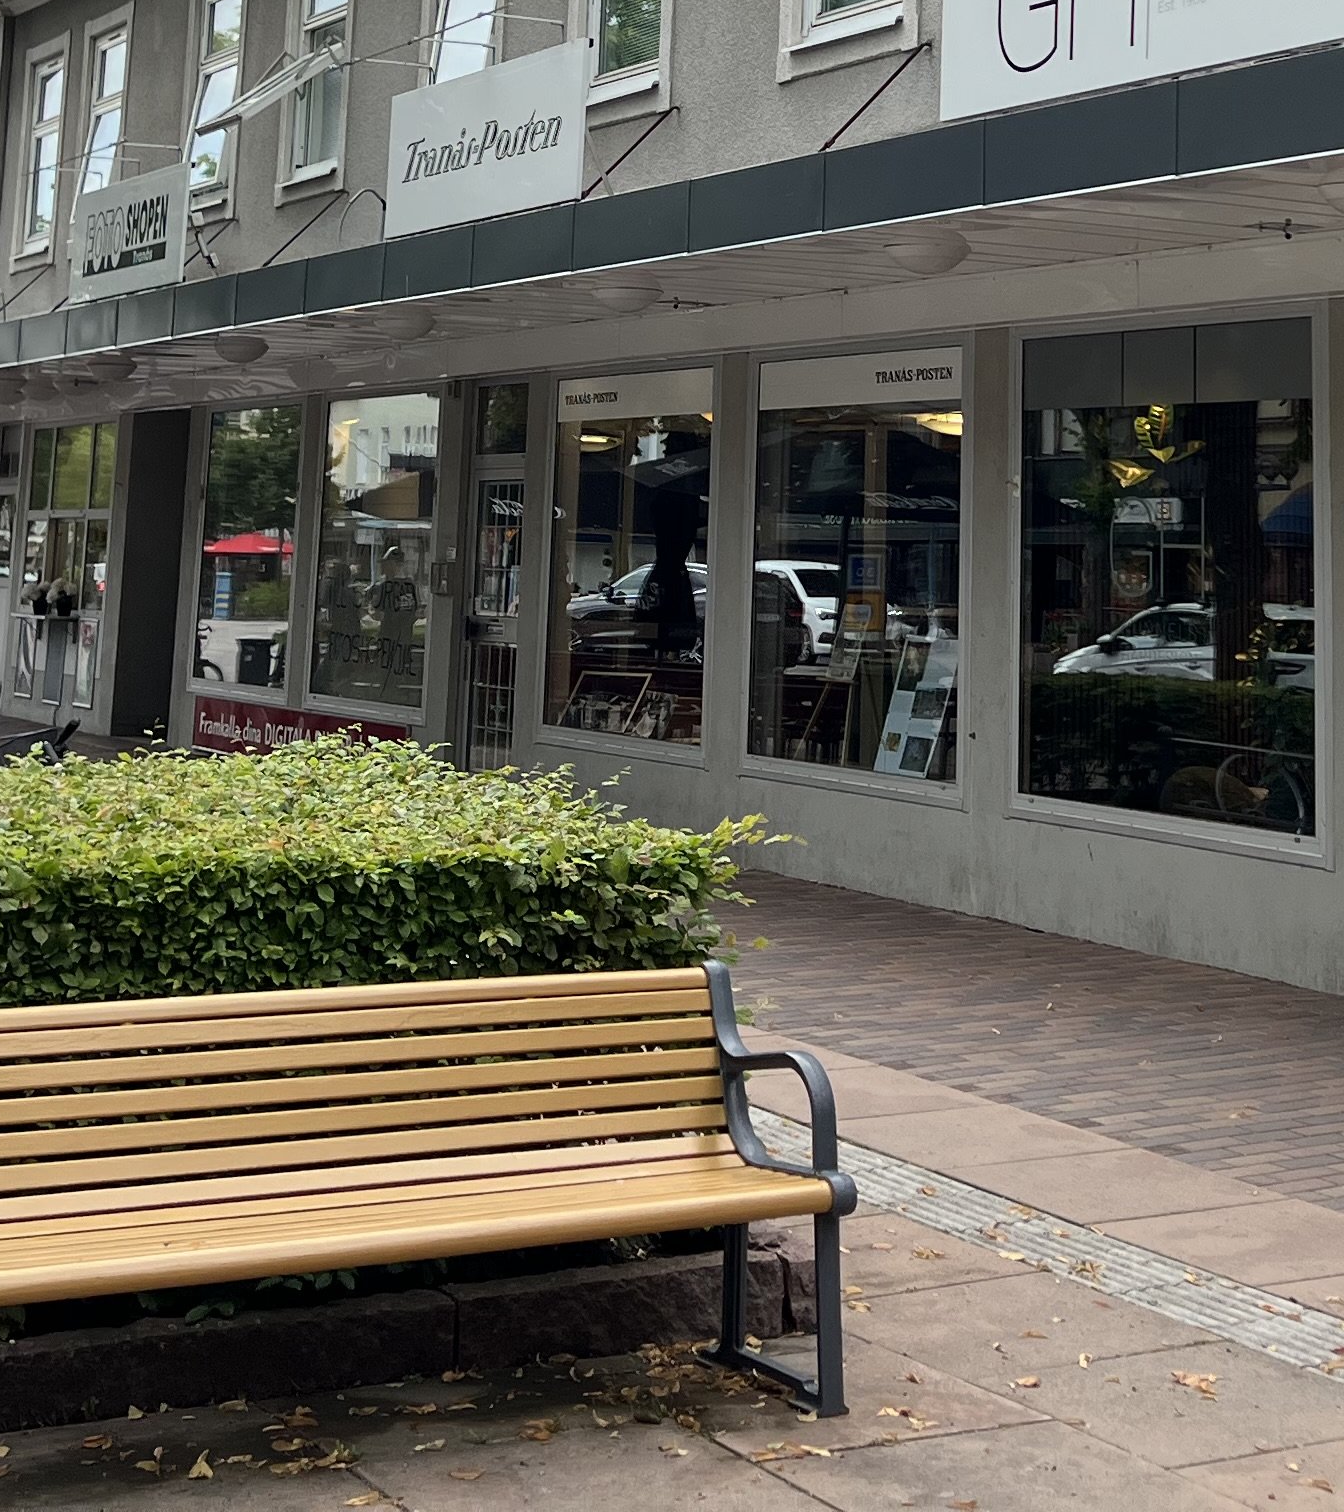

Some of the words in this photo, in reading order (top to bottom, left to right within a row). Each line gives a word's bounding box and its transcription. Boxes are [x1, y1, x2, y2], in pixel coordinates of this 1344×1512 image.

[402, 109, 563, 184] Tranås-Posten
[125, 194, 169, 248] SHOPEN
[875, 366, 953, 384] TRANÅS-POSTEN
[199, 712, 242, 739] Framkalla
[242, 717, 262, 744] dina
